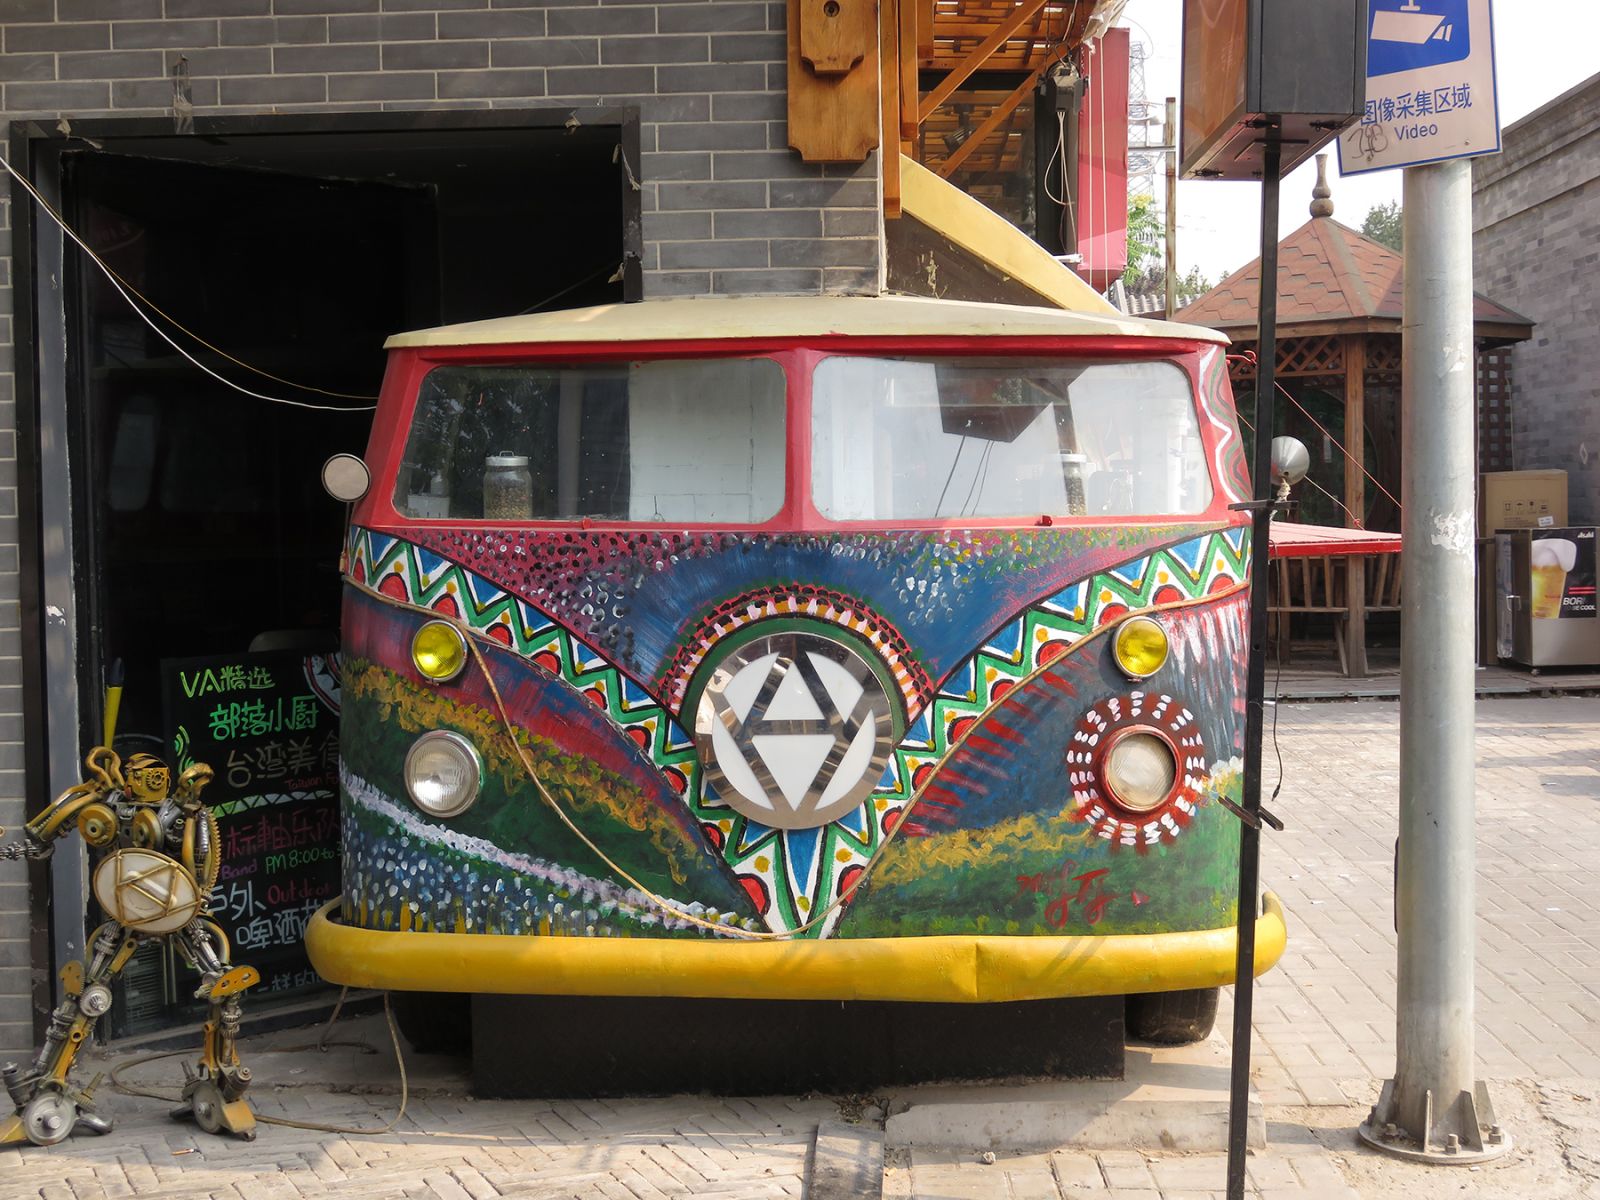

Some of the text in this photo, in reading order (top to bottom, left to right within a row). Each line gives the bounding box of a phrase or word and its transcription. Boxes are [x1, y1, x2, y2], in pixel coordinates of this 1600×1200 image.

[1361, 83, 1472, 125] 图像采集区域
[1394, 123, 1437, 140] Video
[221, 858, 258, 880] Band
[265, 854, 287, 875] PM
[288, 846, 319, 868] 8:00
